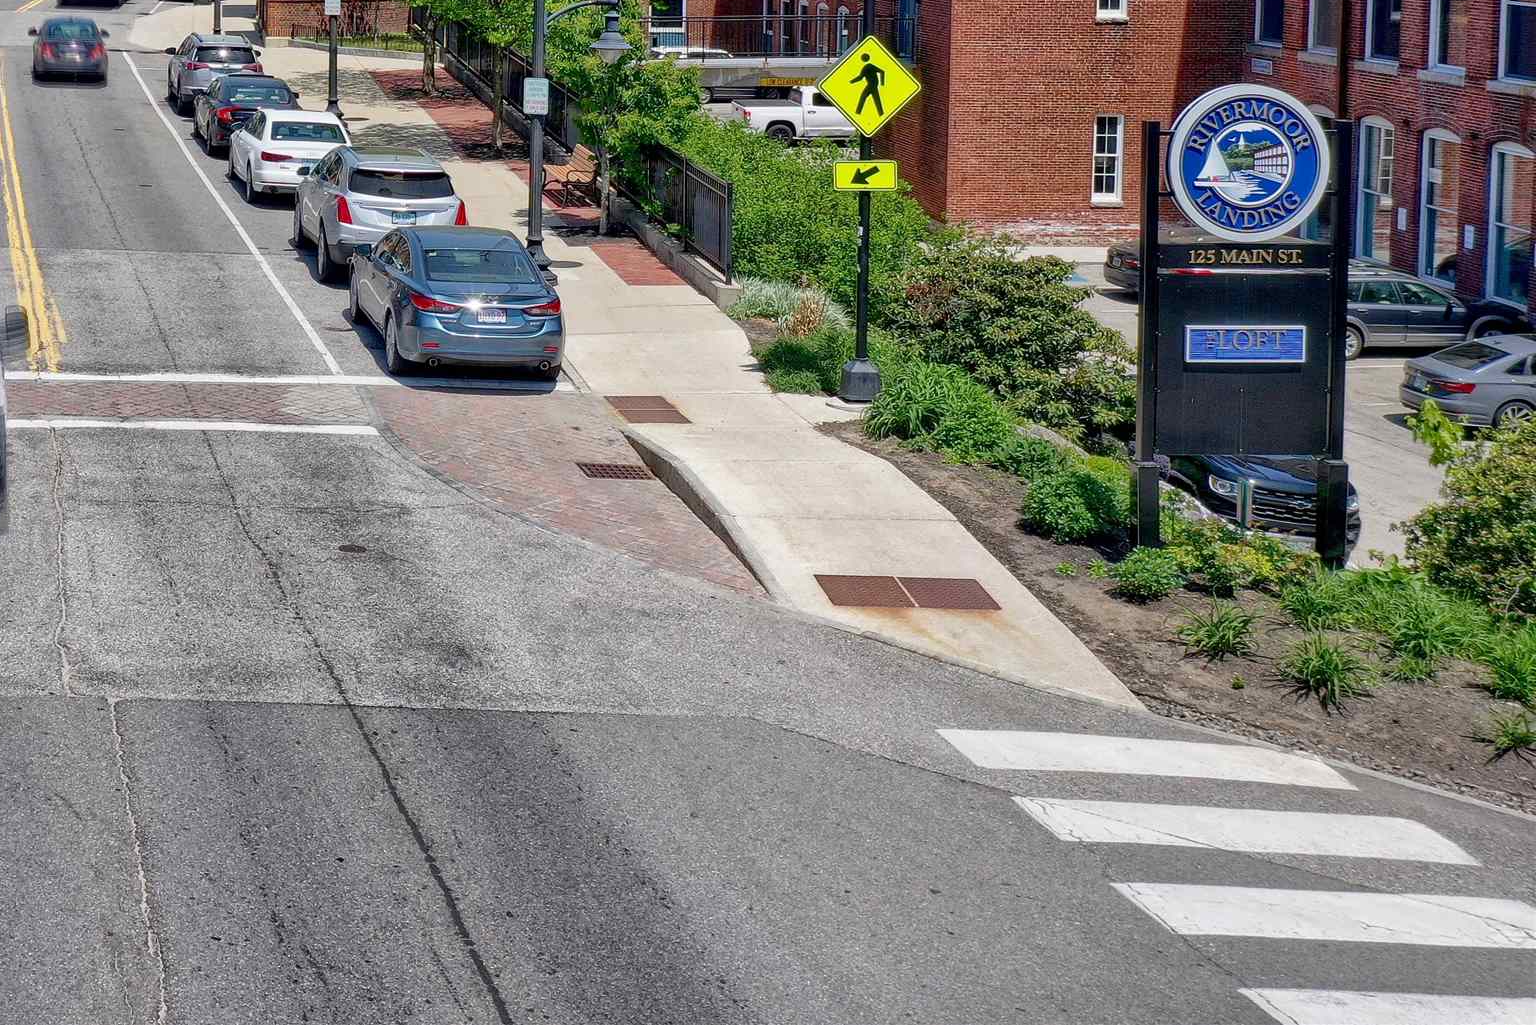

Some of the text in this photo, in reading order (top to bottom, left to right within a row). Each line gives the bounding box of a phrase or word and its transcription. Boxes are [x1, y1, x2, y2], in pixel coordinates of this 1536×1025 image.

[1187, 99, 1313, 152] RIVERMOOR
[1196, 190, 1302, 227] LANDING
[1188, 249, 1303, 264] 125 MAIN ST.
[1217, 330, 1288, 351] LOFT
